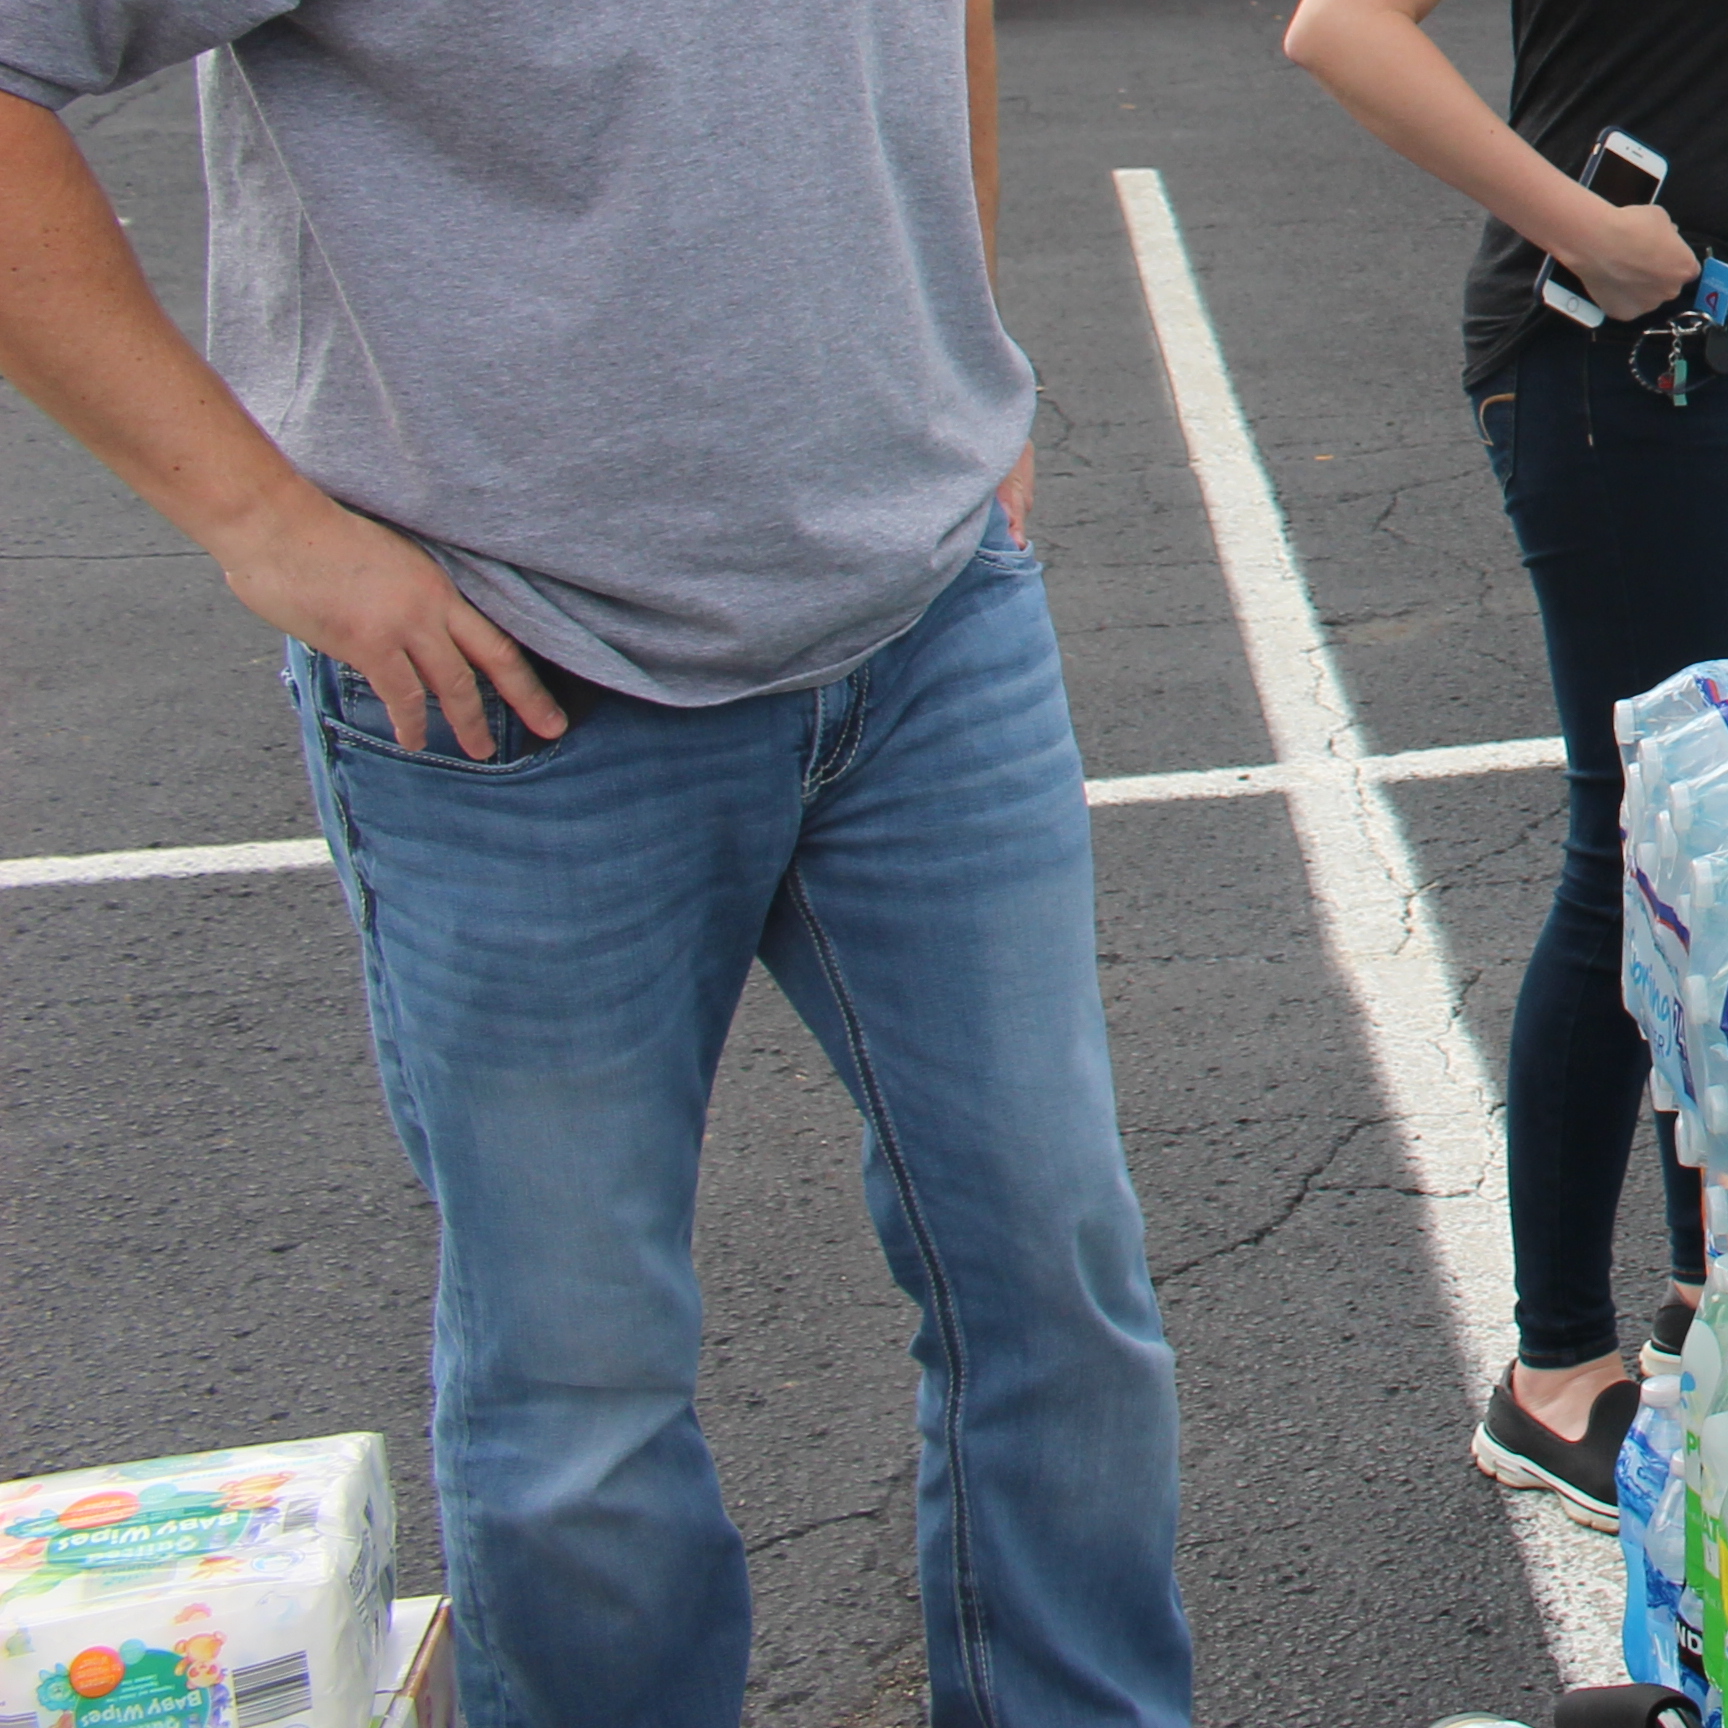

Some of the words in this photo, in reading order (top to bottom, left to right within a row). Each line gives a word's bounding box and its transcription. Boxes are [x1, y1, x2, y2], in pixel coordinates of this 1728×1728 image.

[160, 1511, 239, 1538] BABY
[57, 1526, 151, 1553] Wipes
[80, 1701, 145, 1728] Wipes
[148, 1689, 203, 1716] BABY
